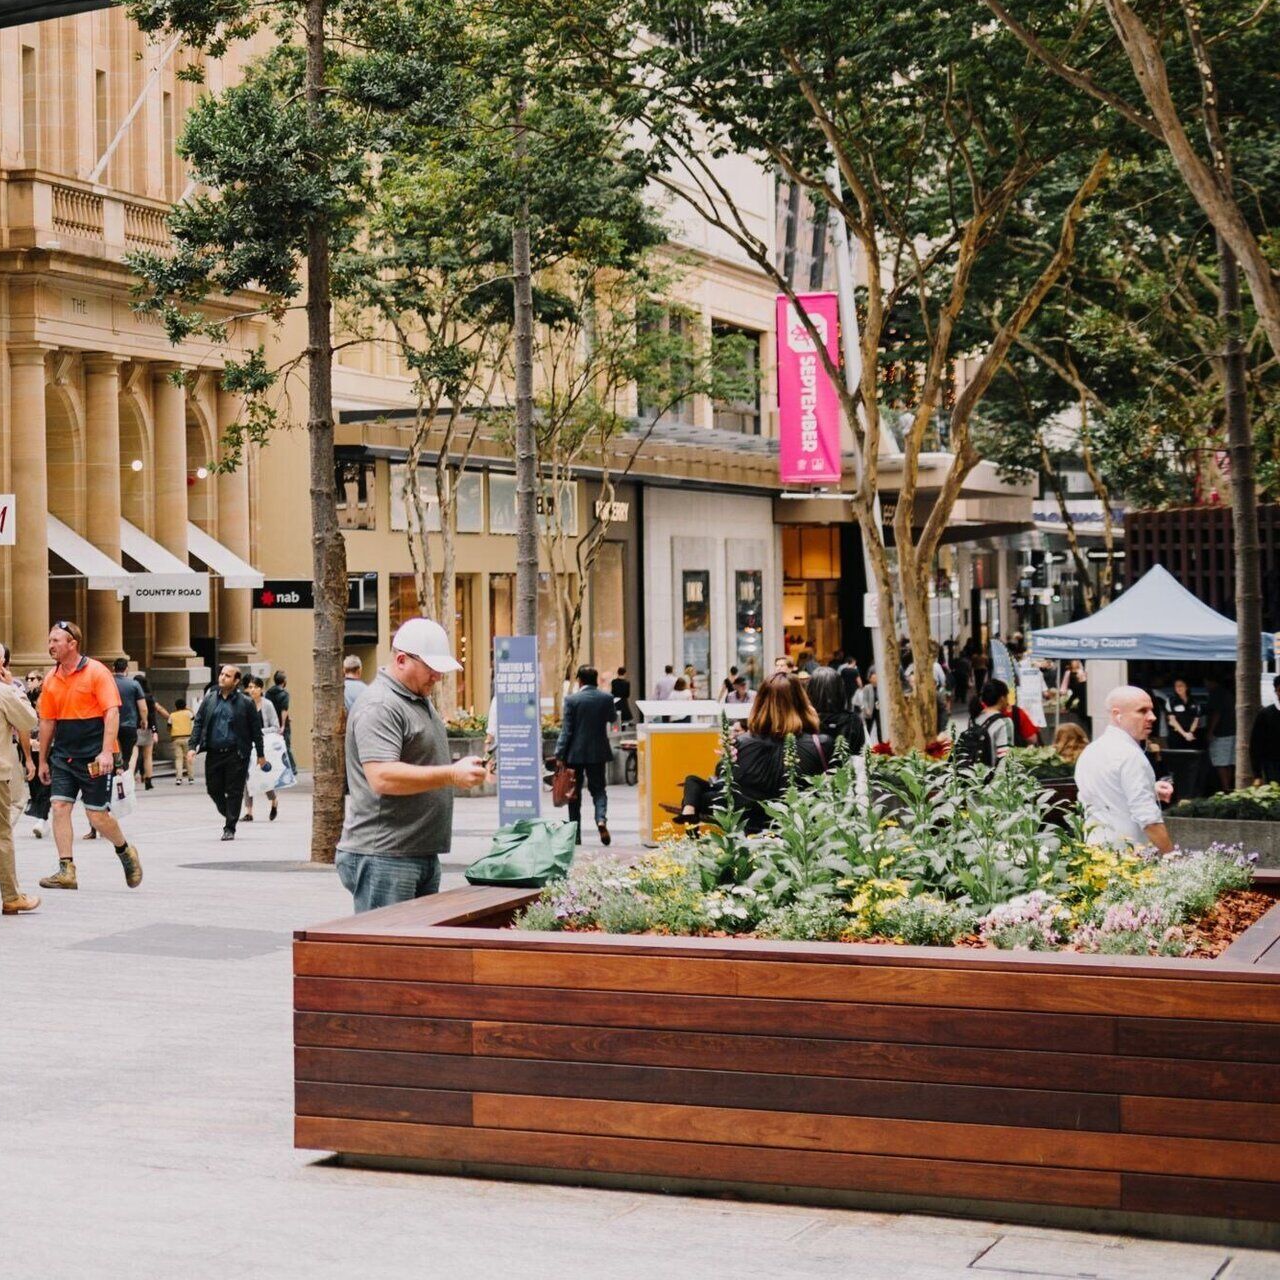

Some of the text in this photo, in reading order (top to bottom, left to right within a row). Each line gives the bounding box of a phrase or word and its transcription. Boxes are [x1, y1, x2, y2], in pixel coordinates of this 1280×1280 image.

[800, 355, 818, 453] SEPTEMBER
[135, 588, 202, 597] COUNTRY ROAD
[276, 592, 300, 604] nab
[1080, 638, 1100, 649] City
[1101, 638, 1138, 648] Council
